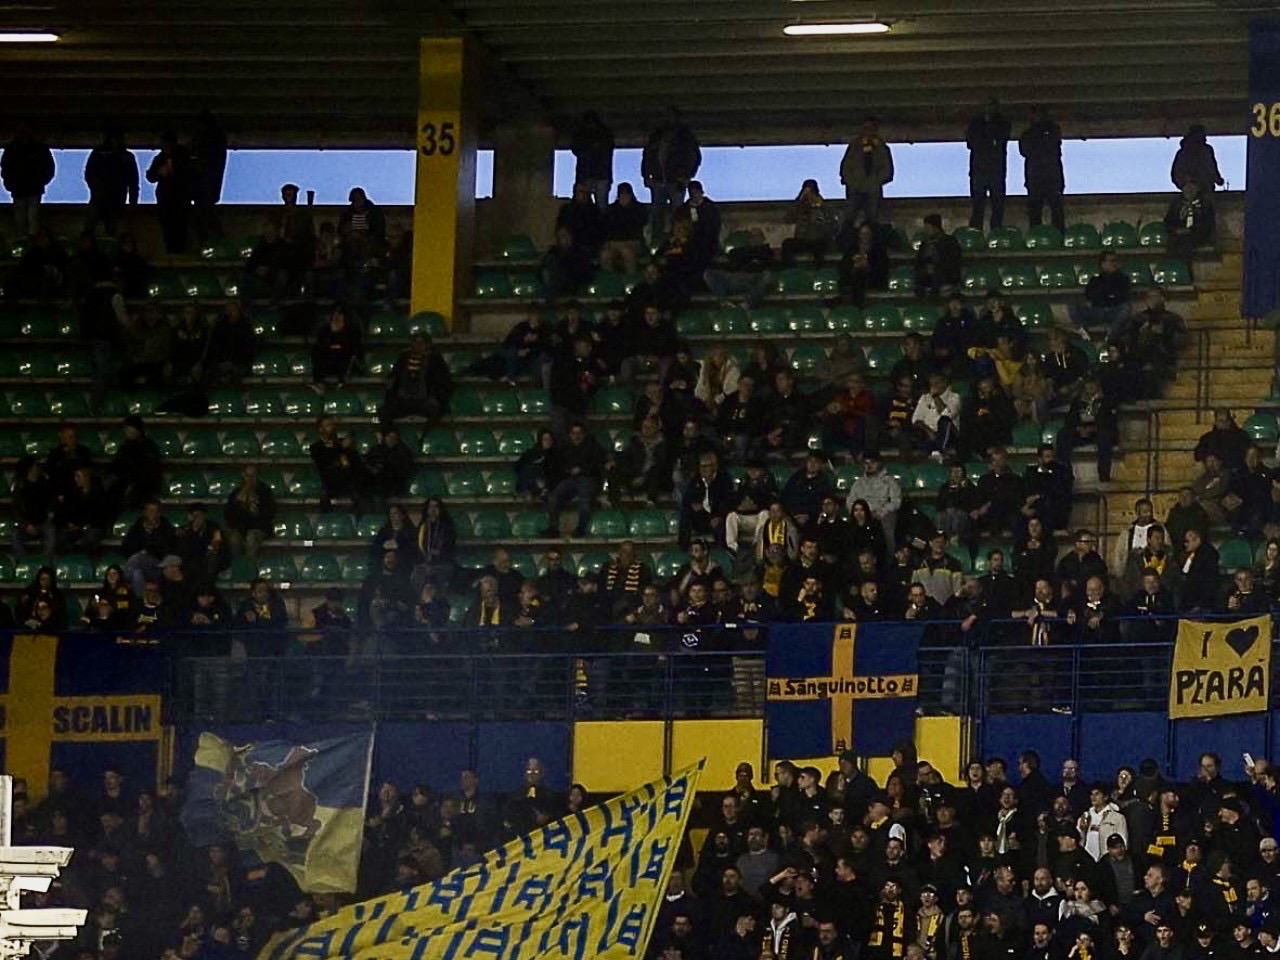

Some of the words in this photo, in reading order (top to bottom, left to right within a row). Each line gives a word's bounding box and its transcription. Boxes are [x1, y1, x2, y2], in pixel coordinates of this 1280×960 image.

[421, 122, 454, 156] 35
[1202, 631, 1212, 658] I
[53, 705, 151, 734] SCALIN
